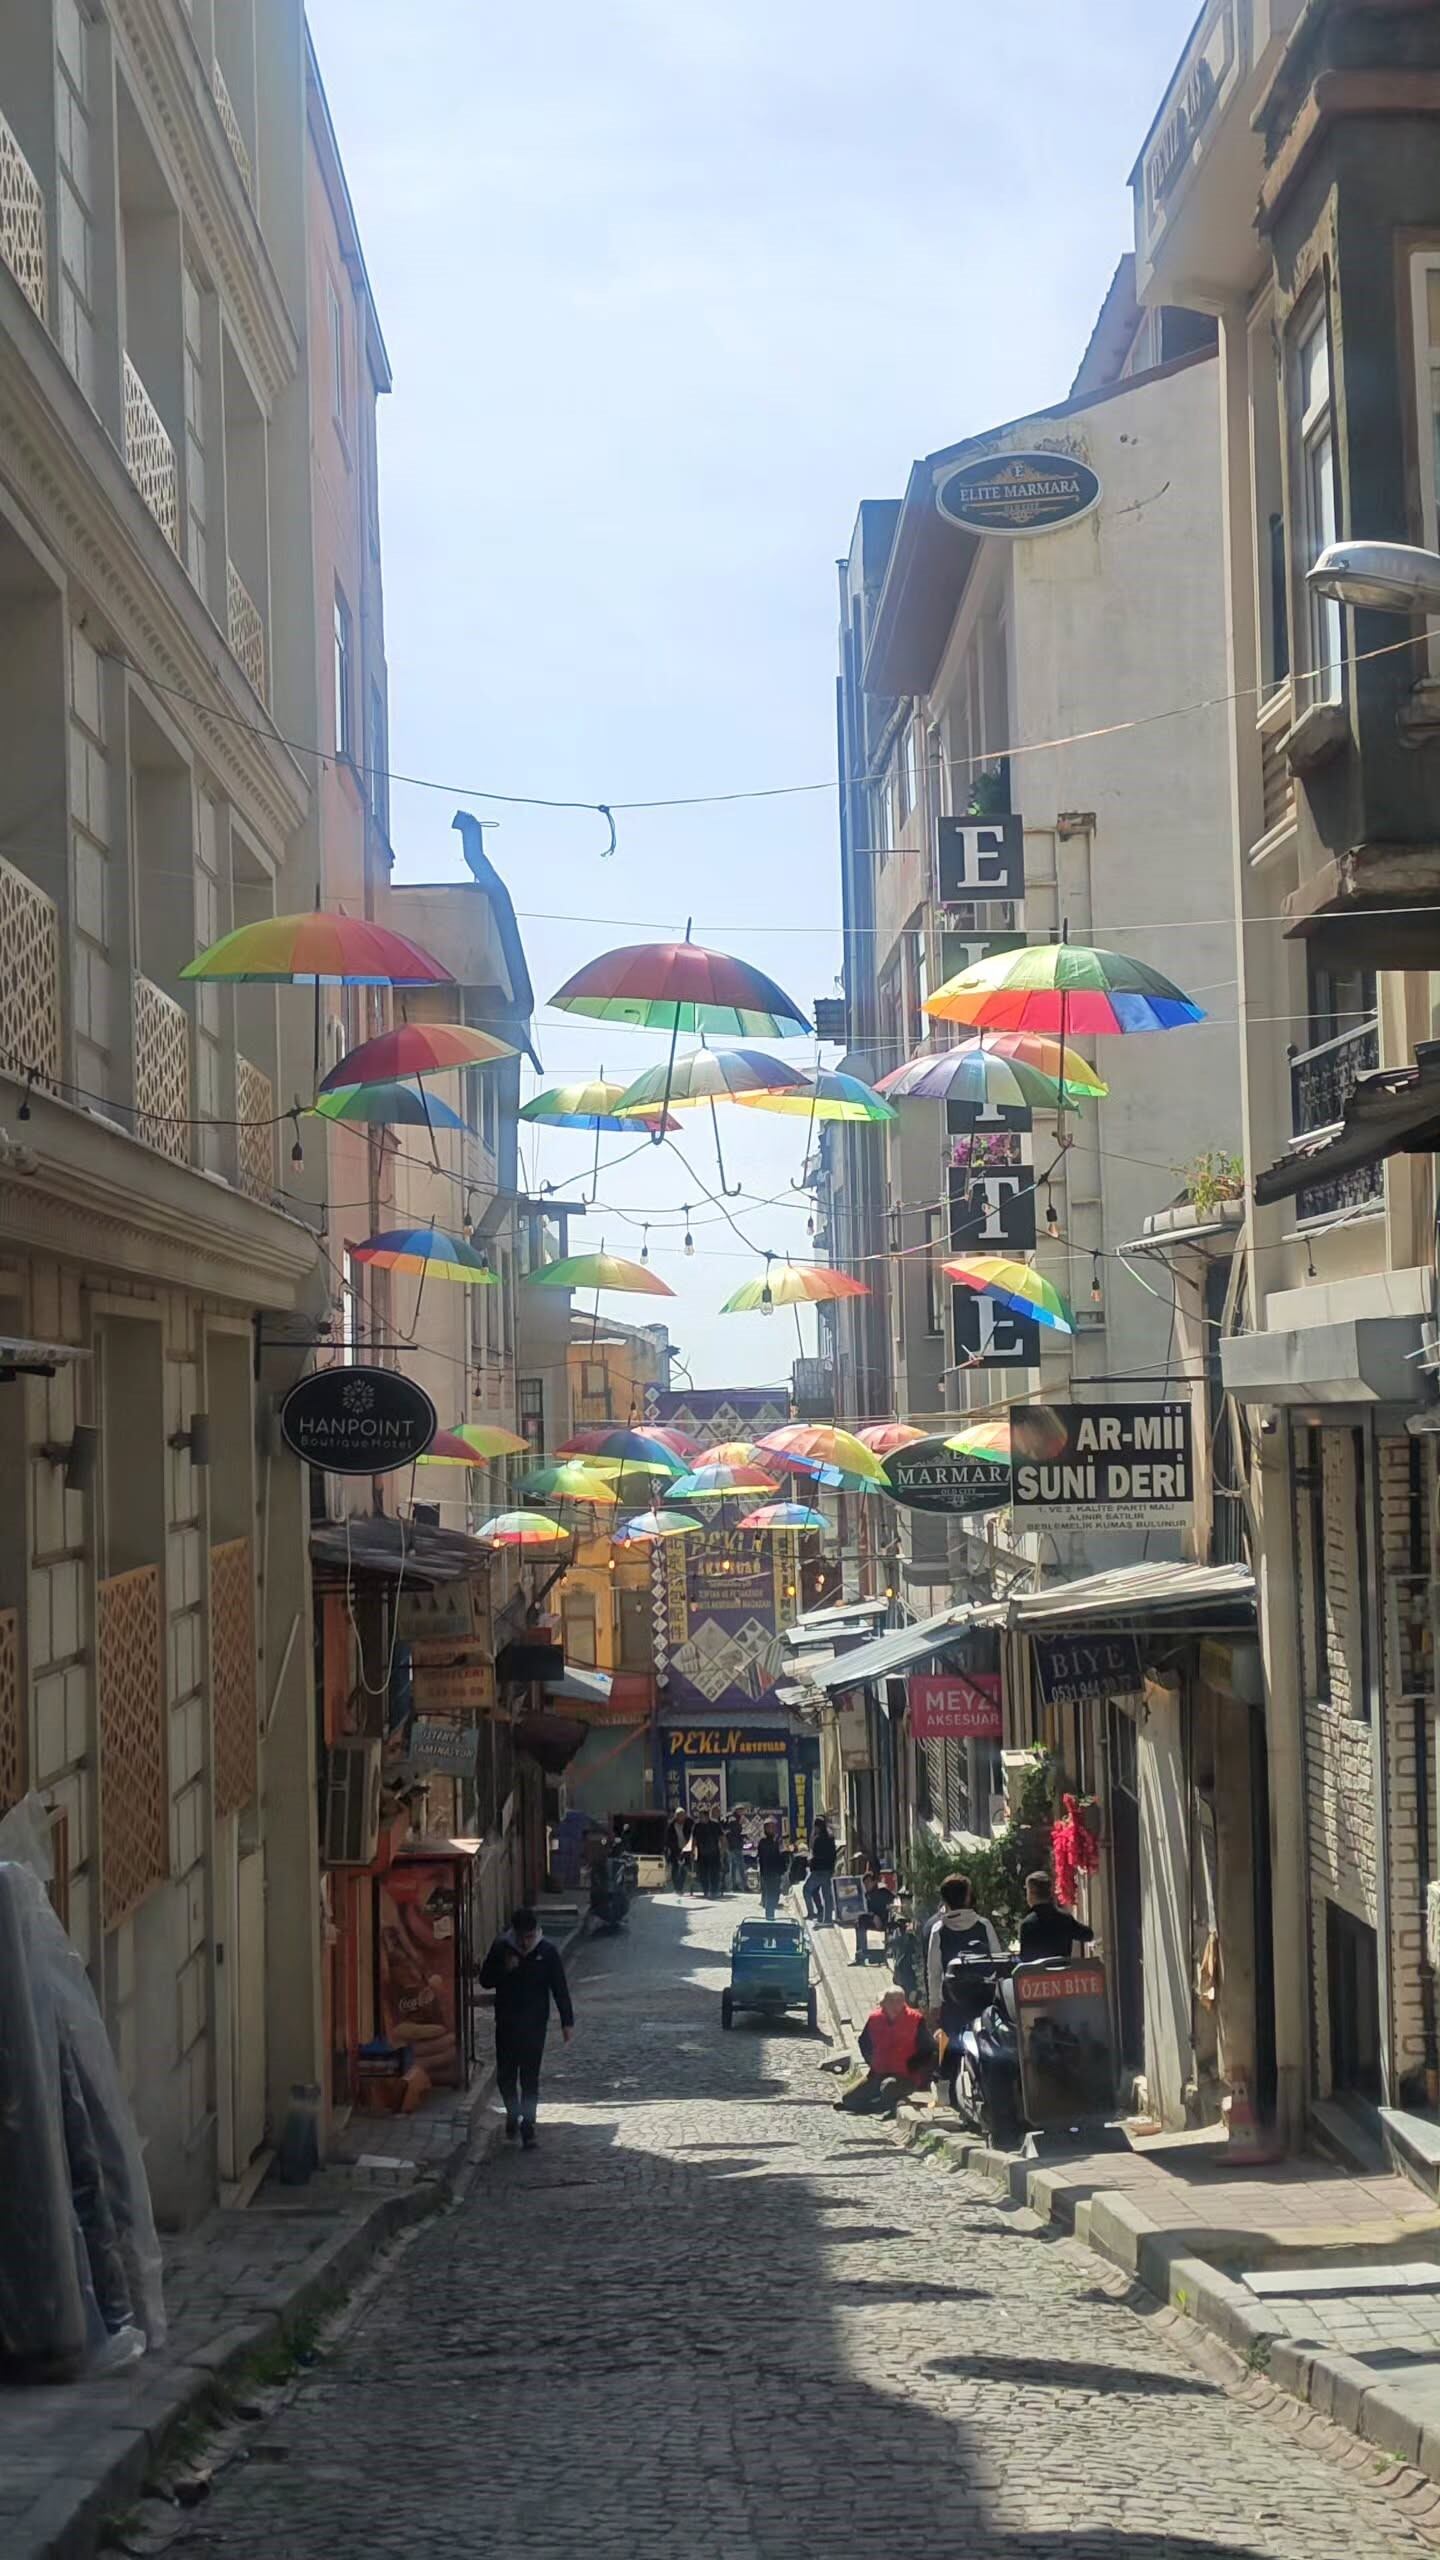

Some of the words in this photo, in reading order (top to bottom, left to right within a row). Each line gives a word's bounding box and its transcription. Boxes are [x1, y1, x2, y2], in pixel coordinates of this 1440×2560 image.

[960, 486, 1001, 502] ELITE
[1004, 480, 1081, 497] MARMARA
[300, 1416, 415, 1437] HANPOINT
[1017, 1455, 1096, 1500] SUNİ
[1107, 1453, 1186, 1498] DERİ
[1136, 1519, 1186, 1528] BULUNUR
[927, 1712, 1000, 1726] AKSESUAR
[1021, 1979, 1063, 1999] ÖZEN
[1064, 1976, 1098, 1994] BİYE
